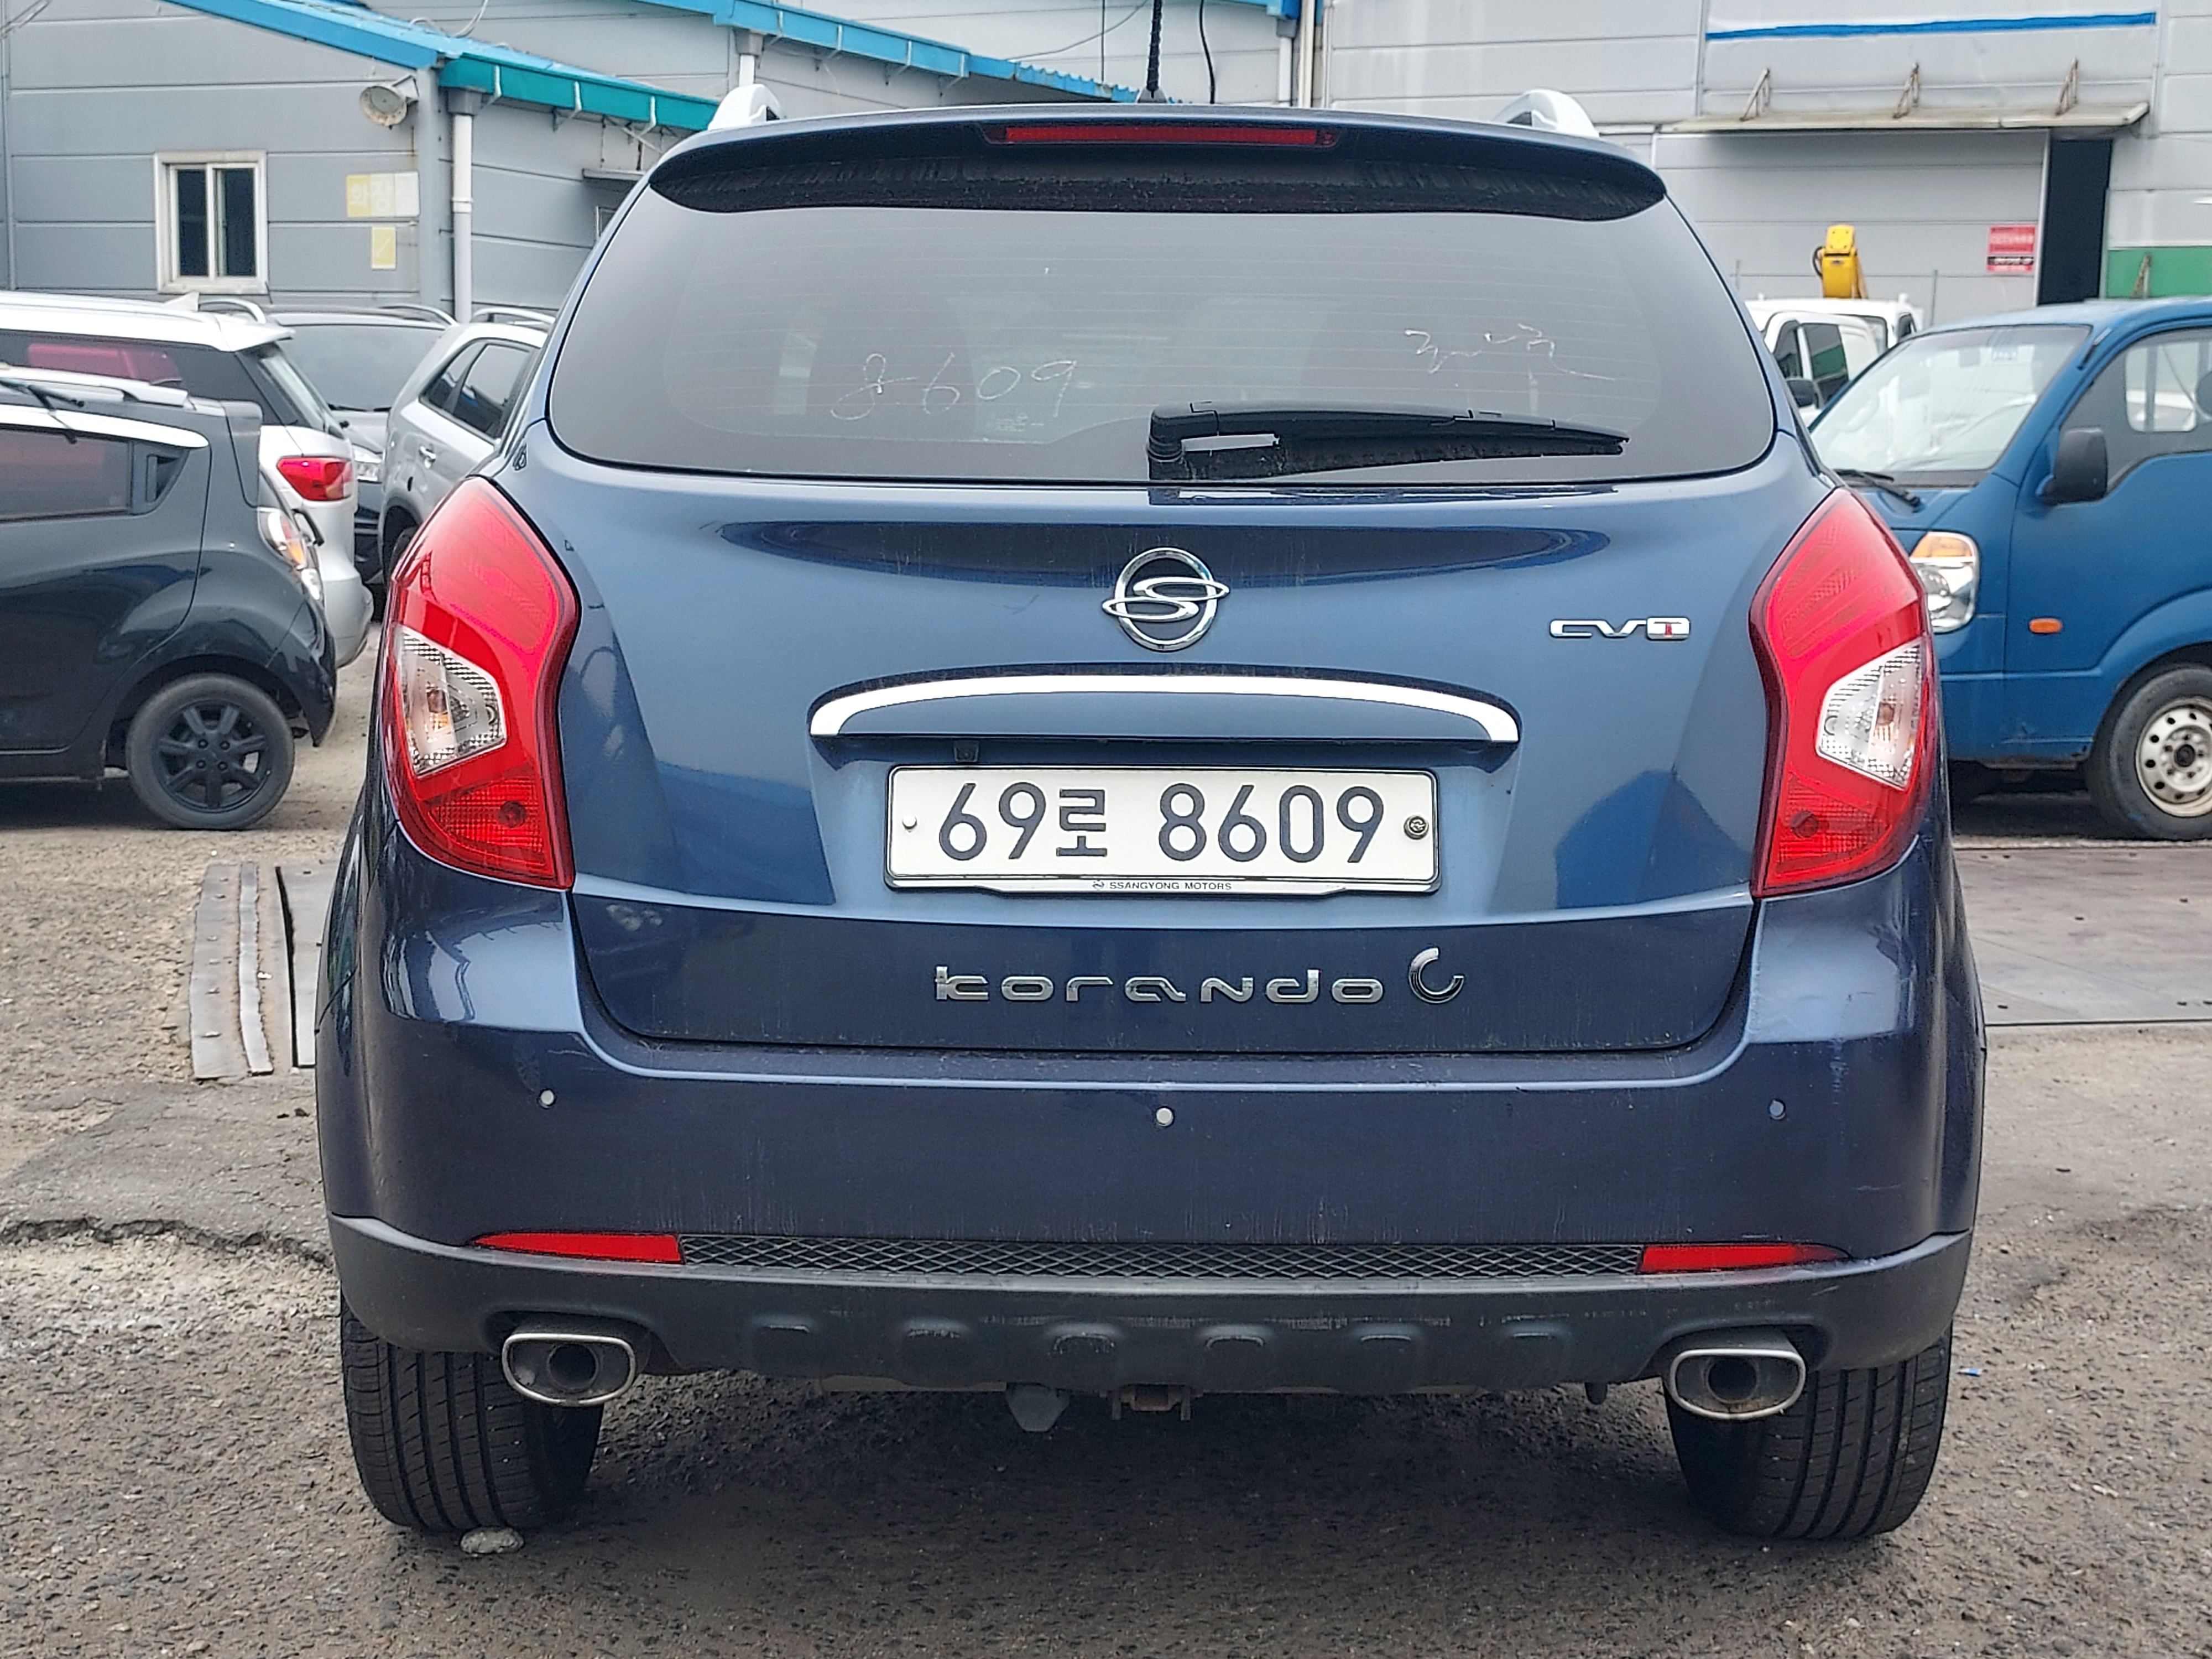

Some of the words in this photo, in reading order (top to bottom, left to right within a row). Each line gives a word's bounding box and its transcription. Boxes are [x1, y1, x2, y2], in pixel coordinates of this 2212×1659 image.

[1550, 617, 1690, 640] CVT
[938, 782, 1108, 861] 69로
[1158, 782, 1384, 863] 8609
[1110, 881, 1180, 890] SSANGYONG
[1185, 881, 1232, 890] MOTORS
